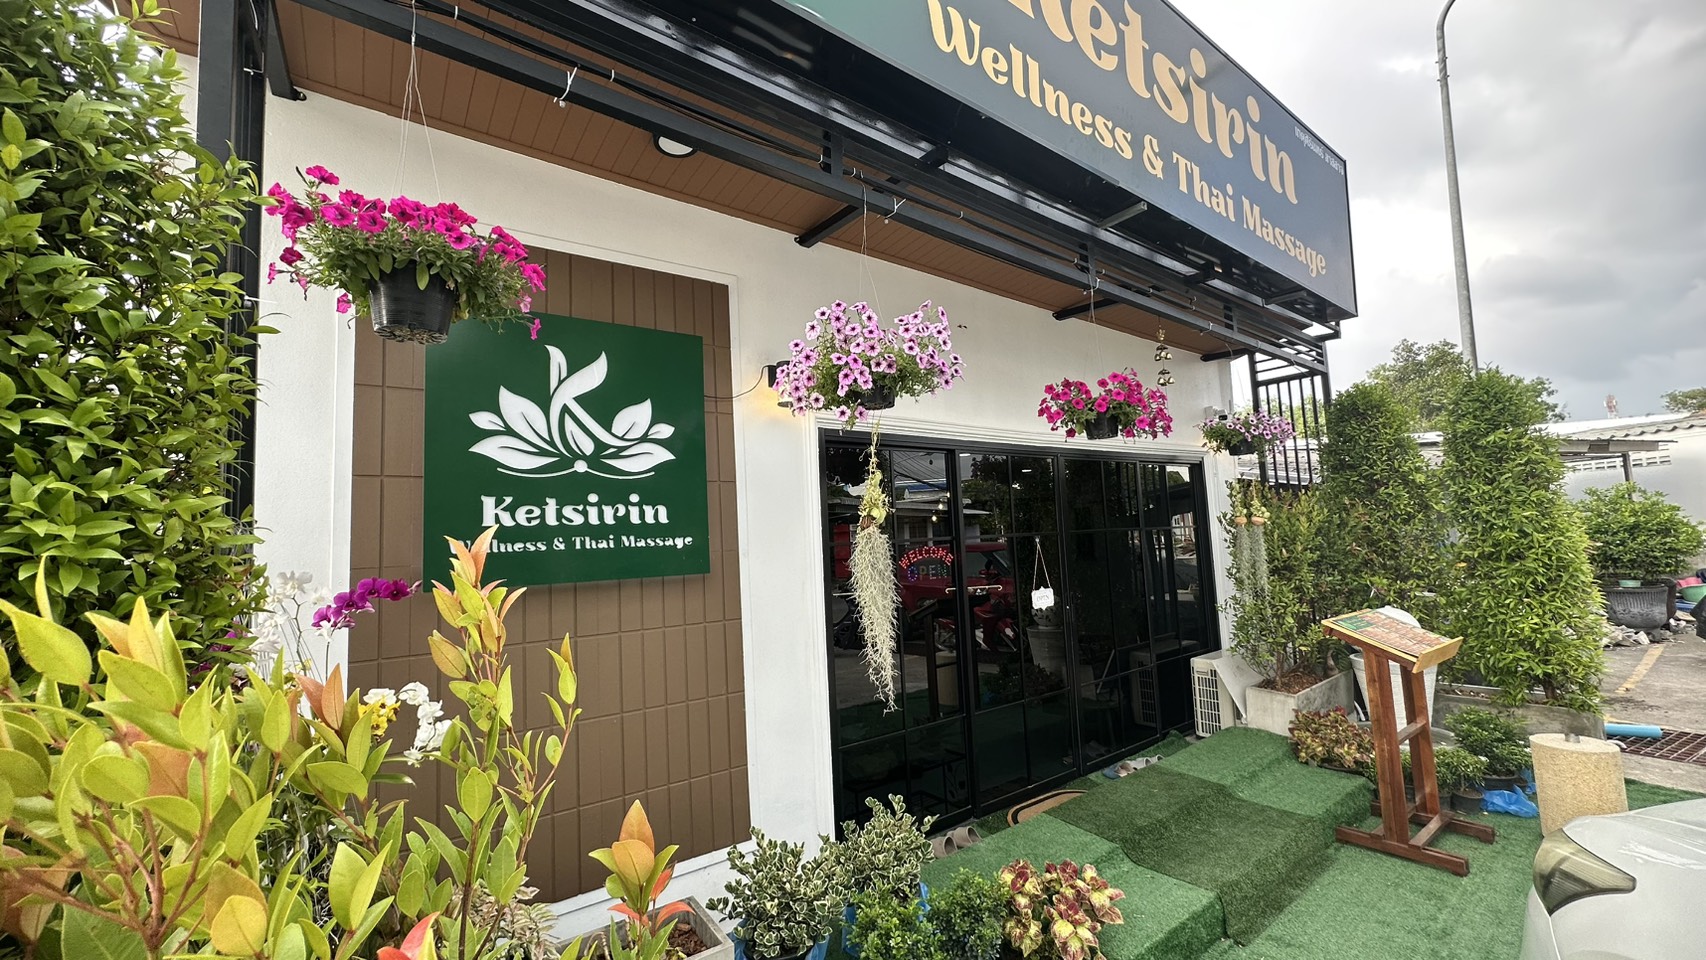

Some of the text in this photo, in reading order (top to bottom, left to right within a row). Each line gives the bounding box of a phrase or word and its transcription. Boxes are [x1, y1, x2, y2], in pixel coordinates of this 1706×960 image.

[1007, 0, 1298, 204] etsirin
[927, 0, 1327, 277] Wellness & Thai Massage
[480, 493, 669, 527] Ketsirin
[449, 534, 693, 555] lness & Thai Massage
[898, 545, 954, 569] WELCOME
[907, 564, 948, 582] OPEN
